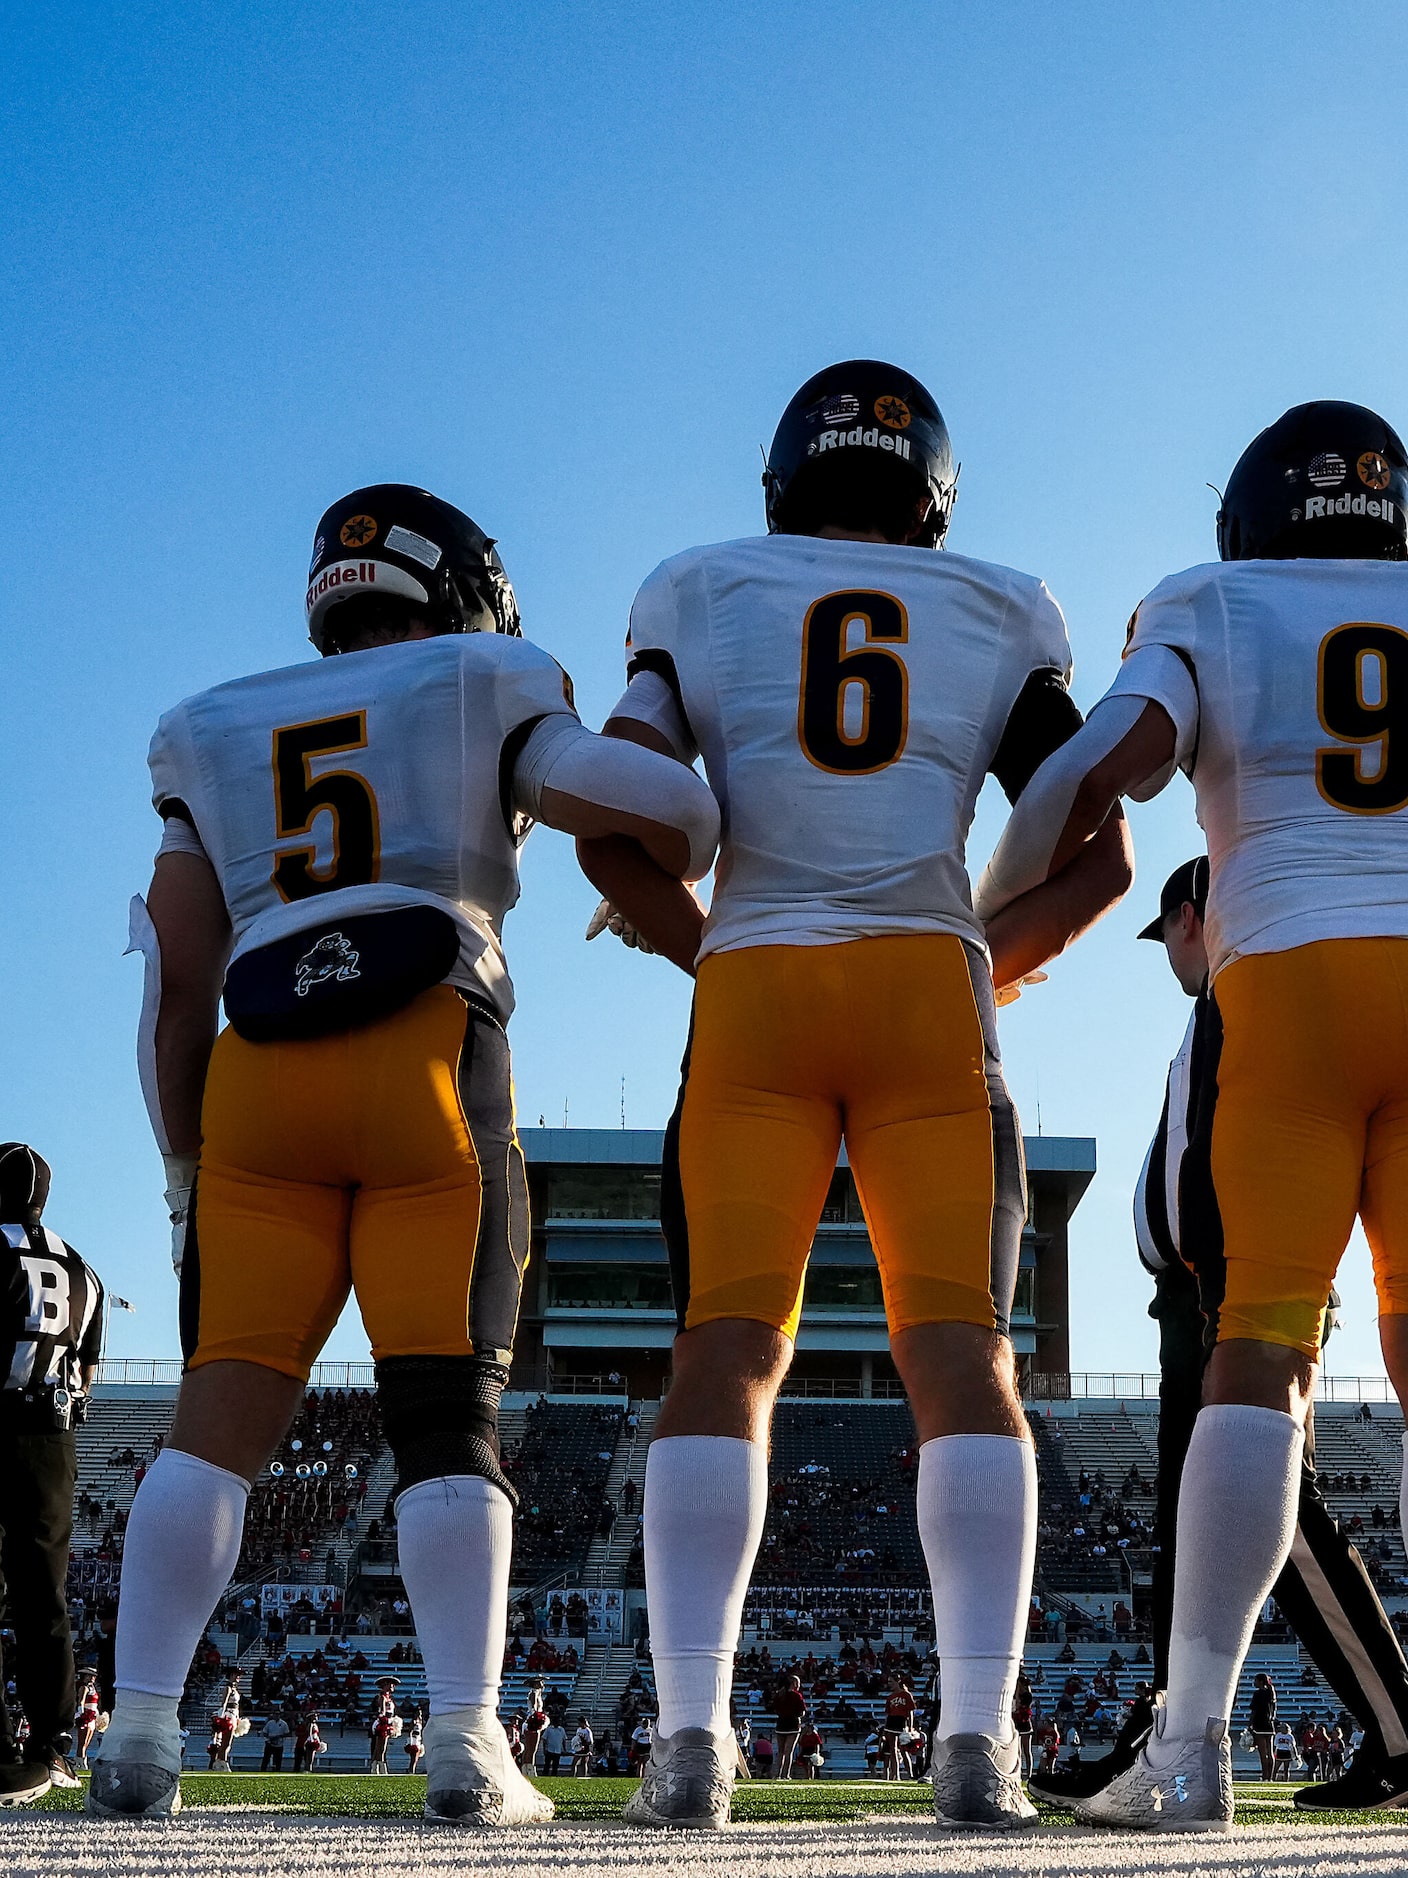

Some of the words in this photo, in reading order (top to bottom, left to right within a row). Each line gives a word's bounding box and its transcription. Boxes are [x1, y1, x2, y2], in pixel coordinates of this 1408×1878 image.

[819, 426, 910, 460] Riddell
[1305, 493, 1394, 524] Riddell
[305, 563, 376, 611] Riddell
[798, 588, 909, 776] 6
[270, 709, 382, 905] 5
[19, 1255, 71, 1337] B
